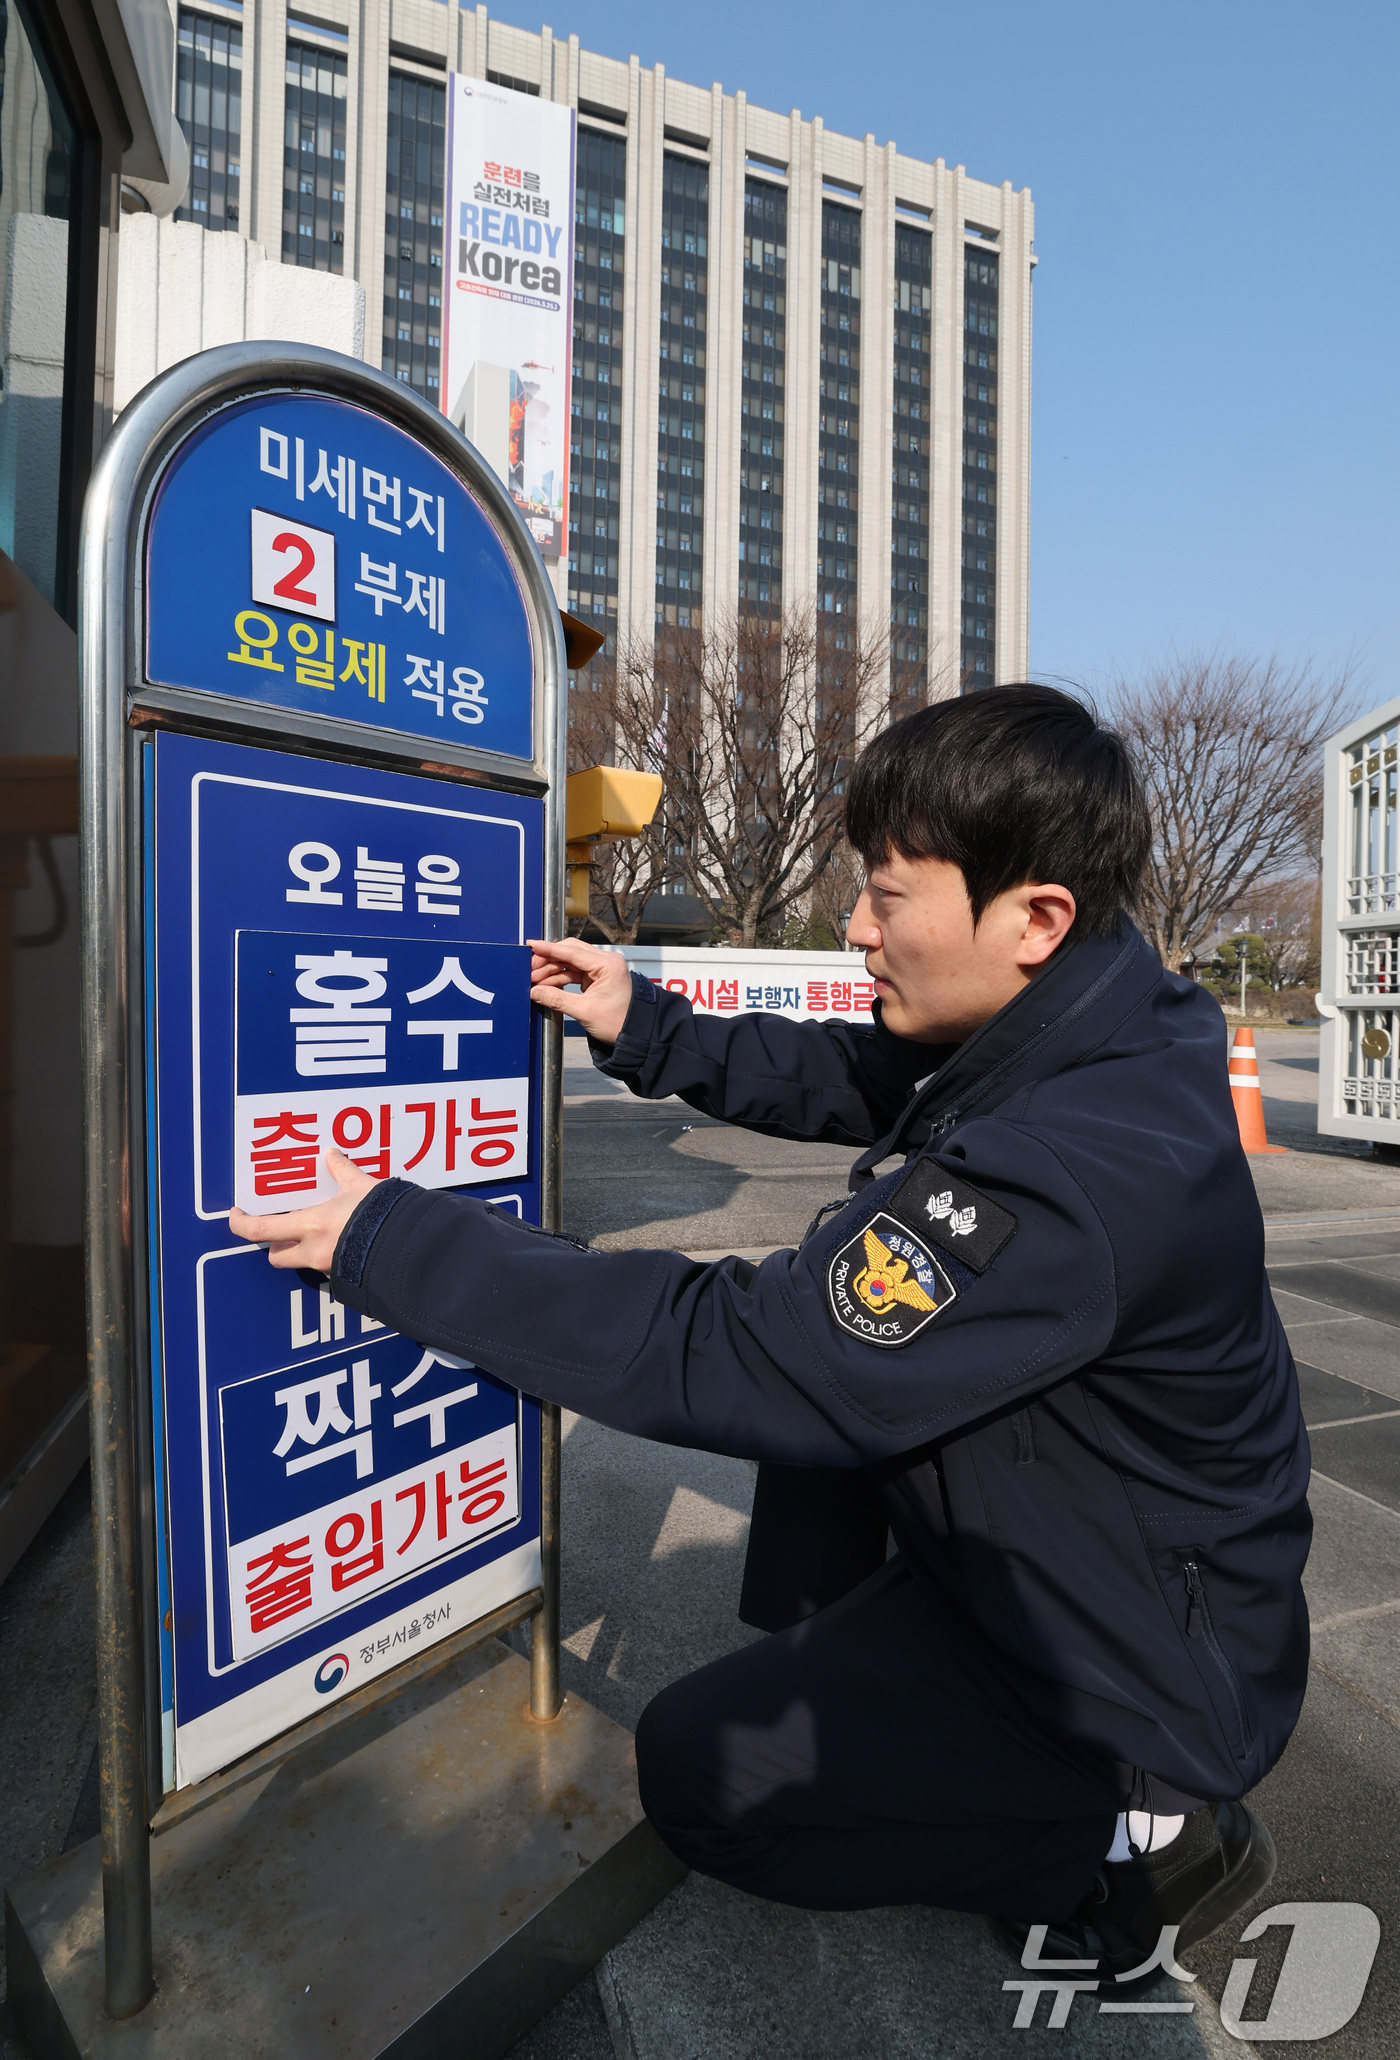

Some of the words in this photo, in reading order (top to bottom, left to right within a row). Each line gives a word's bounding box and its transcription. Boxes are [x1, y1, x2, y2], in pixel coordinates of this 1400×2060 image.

[473, 181, 550, 218] 실전처럼
[484, 161, 541, 193] 훈련을
[458, 239, 561, 296] Korea
[460, 201, 563, 259] READY
[260, 426, 445, 553] 미세먼지
[272, 532, 317, 607] 2
[354, 552, 445, 635] 부제
[227, 610, 386, 703] 요일제
[403, 653, 489, 725] 적용
[286, 841, 462, 916] 오늘은
[289, 950, 496, 1077] 홀수
[745, 986, 801, 1010] 보행자
[250, 1097, 519, 1197] 출입가능
[888, 1235, 933, 1284] 청원경찰
[834, 1260, 855, 1317] PRIVATE
[852, 1314, 903, 1336] POLICE
[271, 1345, 479, 1480] 짝수
[245, 1457, 508, 1634] 출입가능
[359, 1602, 452, 1665] 정부서울청사
